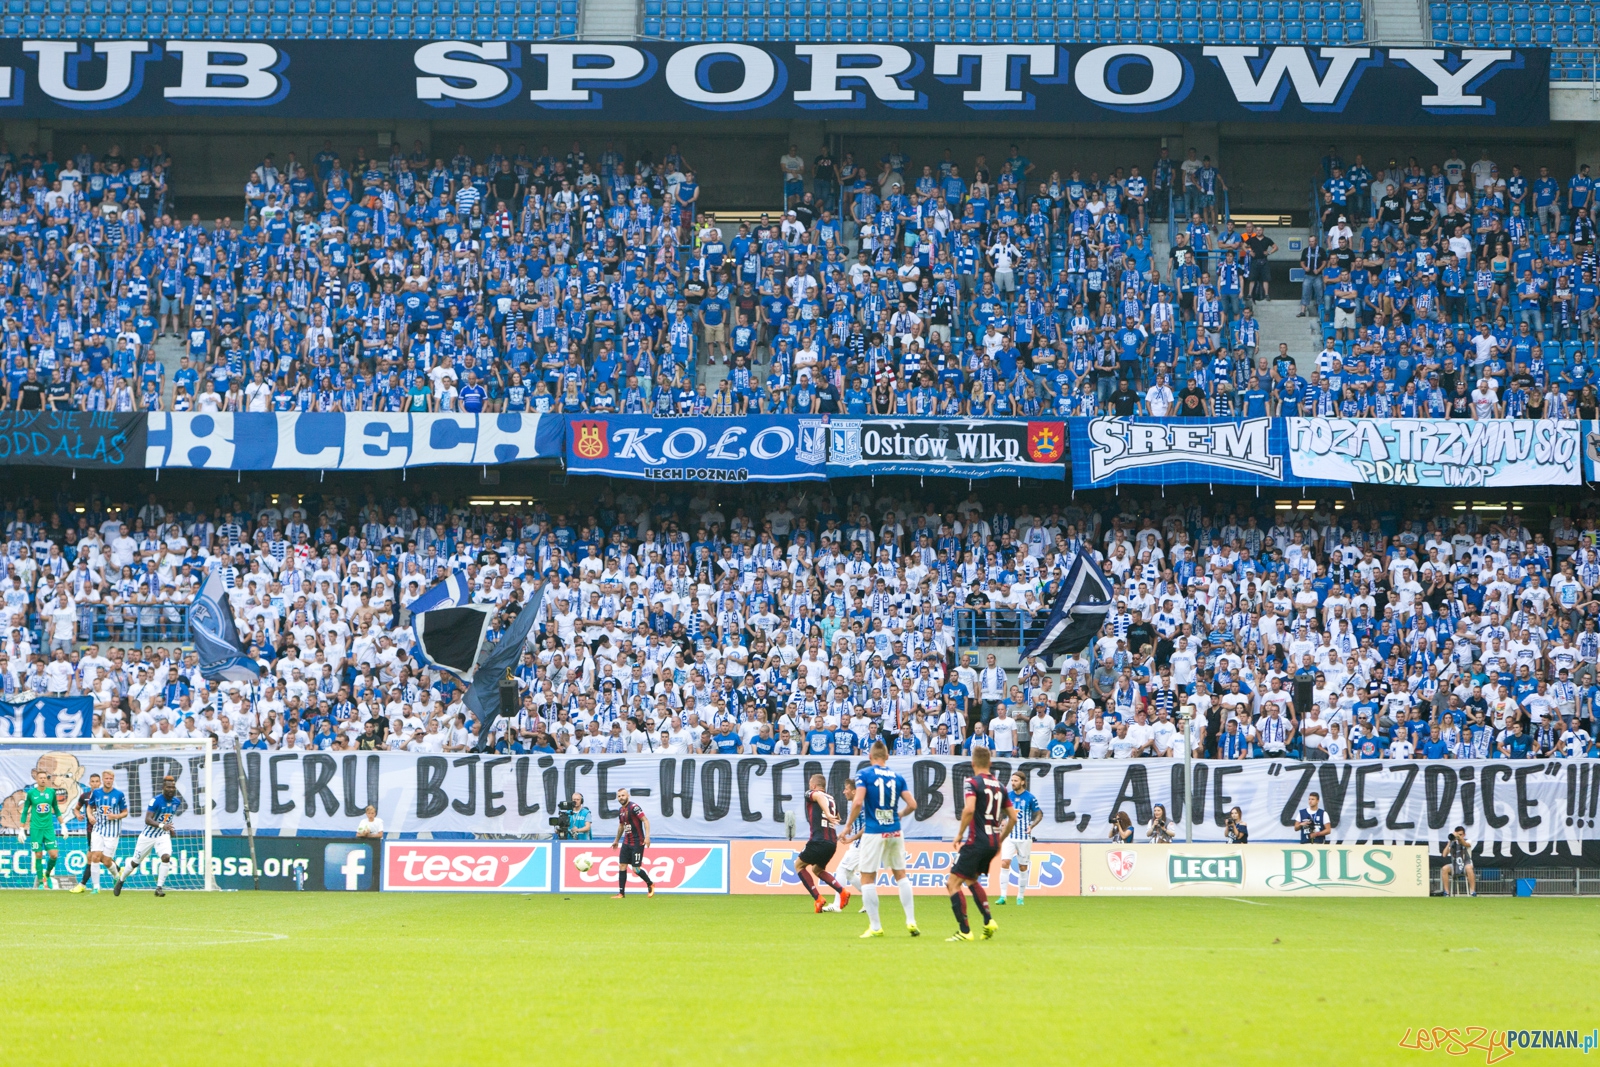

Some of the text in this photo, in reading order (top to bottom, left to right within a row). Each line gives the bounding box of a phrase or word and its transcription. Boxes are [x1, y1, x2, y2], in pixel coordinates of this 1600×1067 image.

[0, 40, 1526, 114] UB SPORTOWY
[47, 411, 81, 433] SIĘ
[89, 411, 119, 429] NIE
[0, 430, 127, 464] ODDAŁAŚ
[271, 412, 541, 469] LECH
[612, 426, 795, 465] KOŁO
[864, 429, 949, 457] Ostrów
[1089, 416, 1272, 467] ŚREM
[645, 467, 749, 481] LECH POZNAŃ
[36, 803, 50, 814] STS
[874, 777, 896, 808] 11
[984, 789, 1003, 822] 21
[1107, 764, 1151, 826] A
[99, 805, 113, 815] STS
[398, 850, 501, 882] tesa
[635, 853, 641, 861] 11
[1173, 859, 1239, 879] LECH
[1279, 848, 1397, 888] PILS
[1415, 854, 1423, 886] SPONSOR
